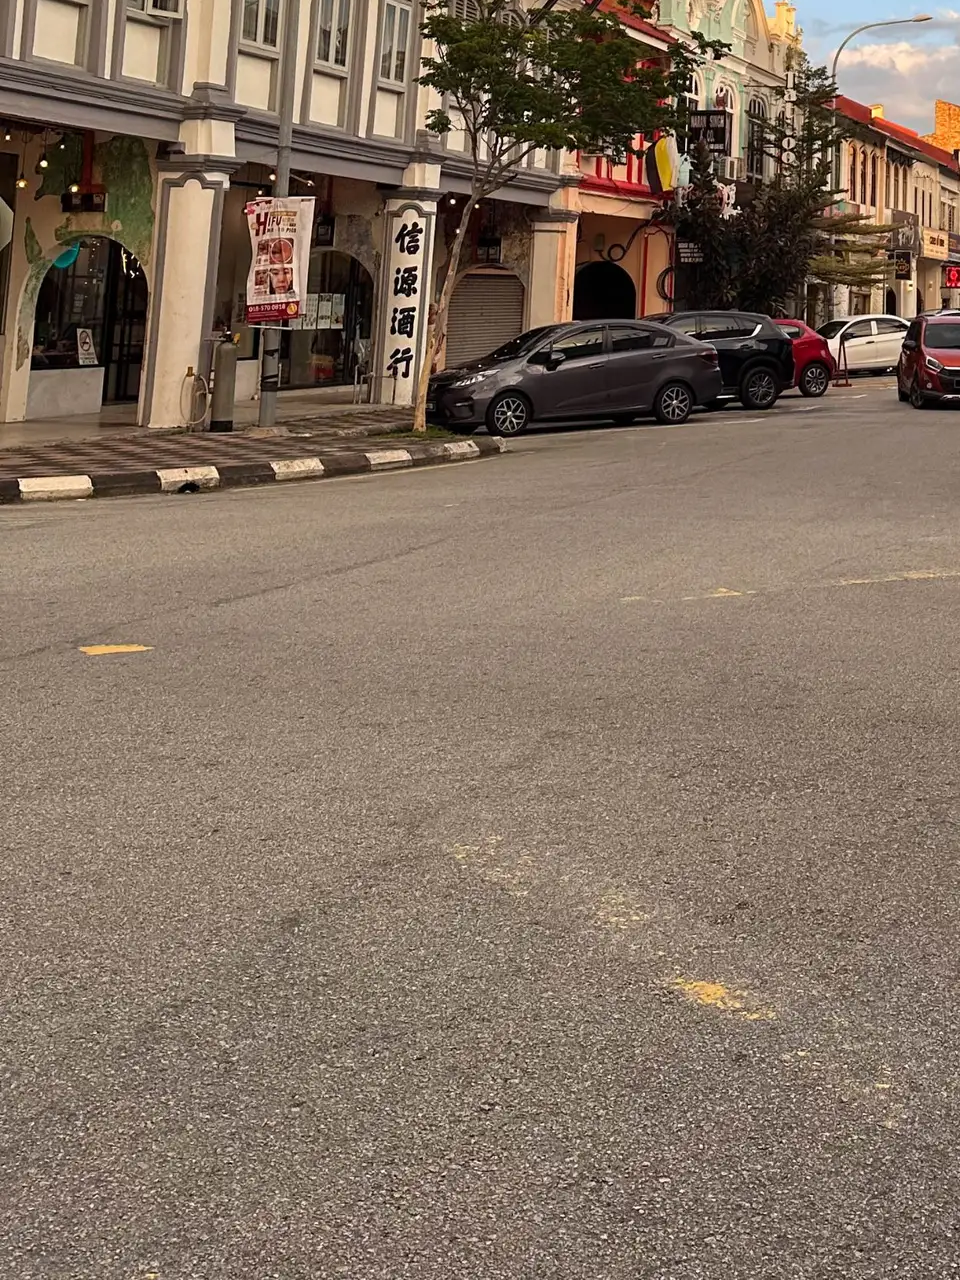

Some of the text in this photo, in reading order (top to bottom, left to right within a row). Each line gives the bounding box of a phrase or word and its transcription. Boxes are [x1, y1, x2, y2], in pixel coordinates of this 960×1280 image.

[255, 211, 283, 236] HIFU
[386, 221, 424, 379] 信源酒行
